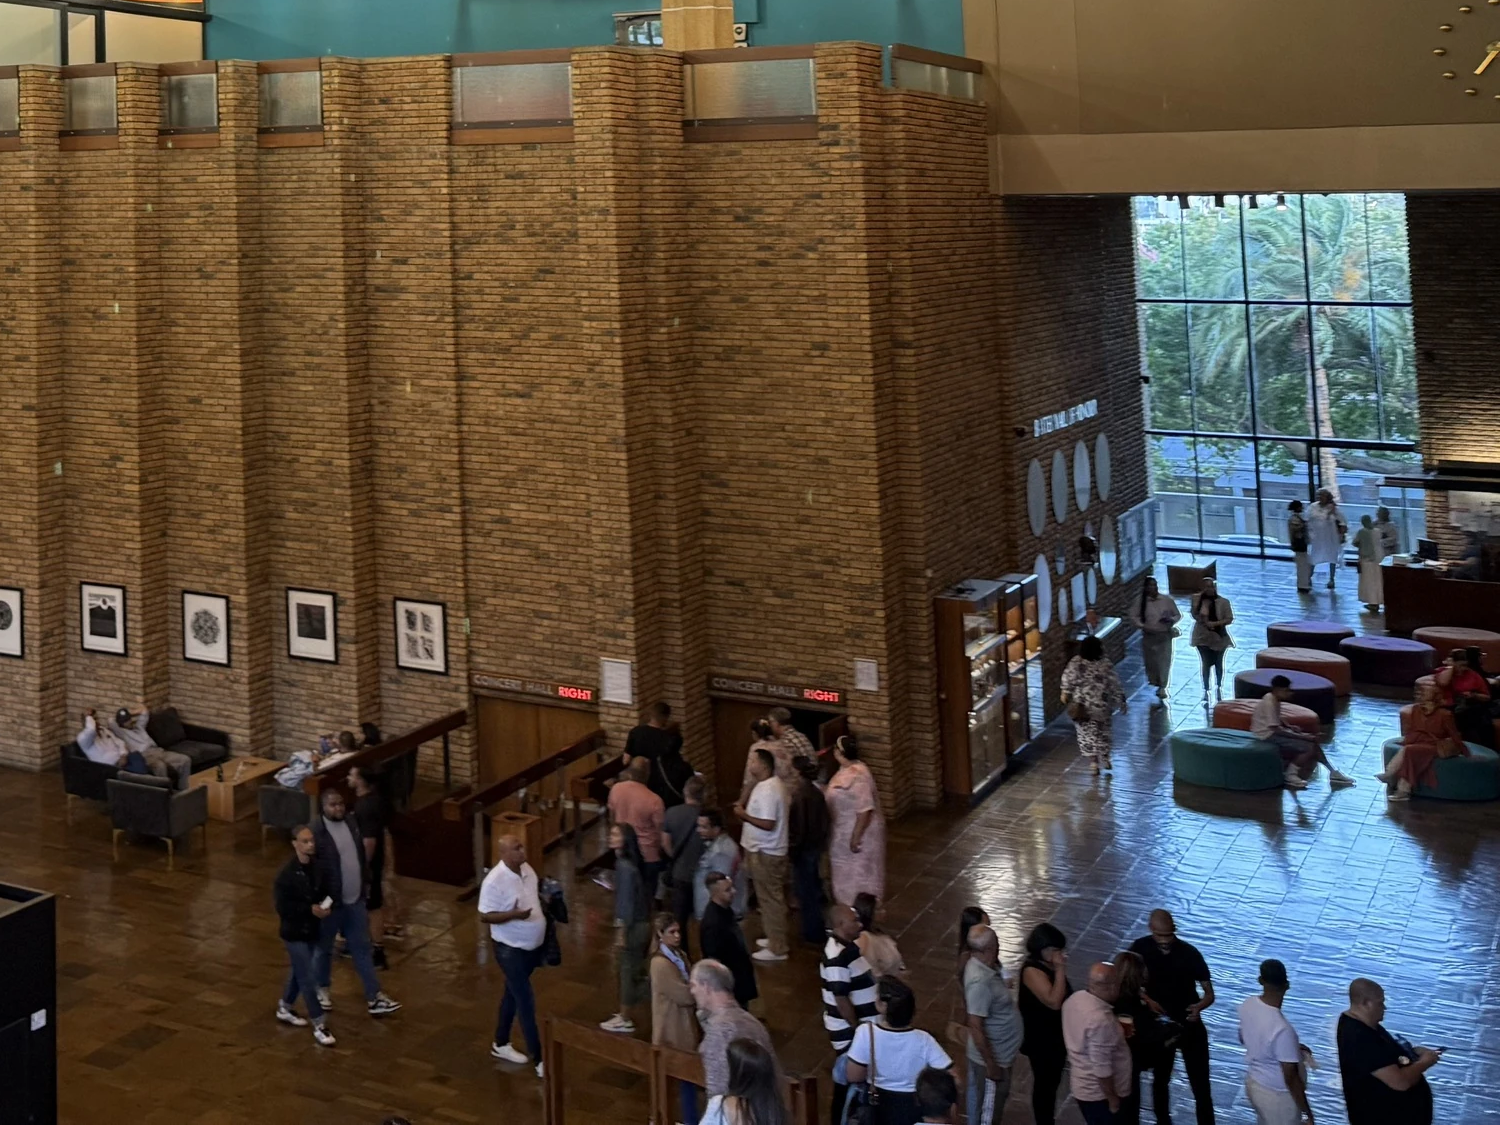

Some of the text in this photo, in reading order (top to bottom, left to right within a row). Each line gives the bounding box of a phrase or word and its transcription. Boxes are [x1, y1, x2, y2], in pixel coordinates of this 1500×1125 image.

[473, 674, 592, 701] CONCERT HALL RIGHT
[712, 677, 839, 702] CONCERT HALL RIGHT
